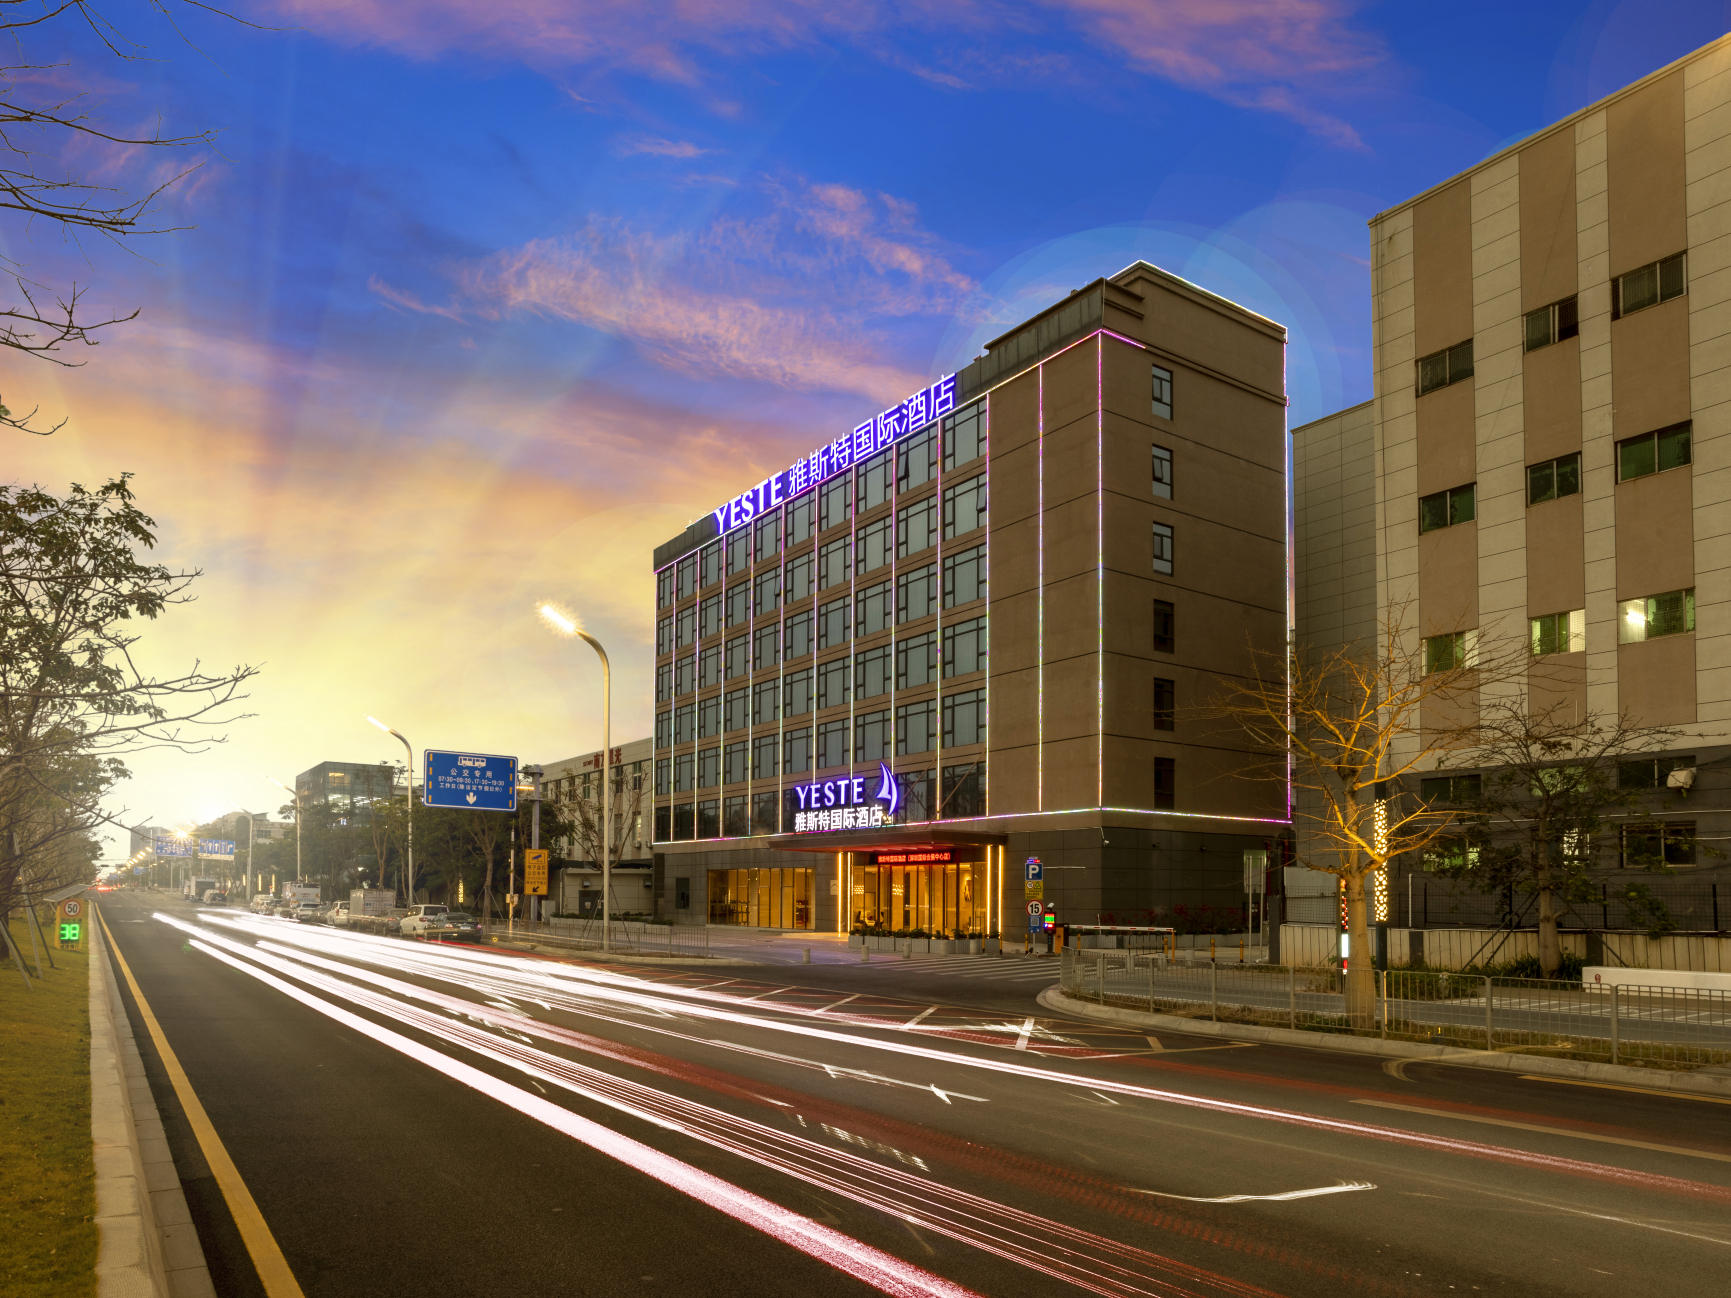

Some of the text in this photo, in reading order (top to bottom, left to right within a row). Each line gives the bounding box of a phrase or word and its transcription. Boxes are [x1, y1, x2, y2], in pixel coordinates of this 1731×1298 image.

[713, 372, 957, 536] YESTE 雅斯特国际酒店
[450, 768, 493, 779] 公交专用
[795, 777, 864, 810] YESTE
[794, 804, 884, 832] 雅斯特国际酒店
[1029, 865, 1039, 879] P
[67, 904, 78, 913] 50
[1030, 903, 1040, 914] 15
[60, 924, 79, 940] 38
